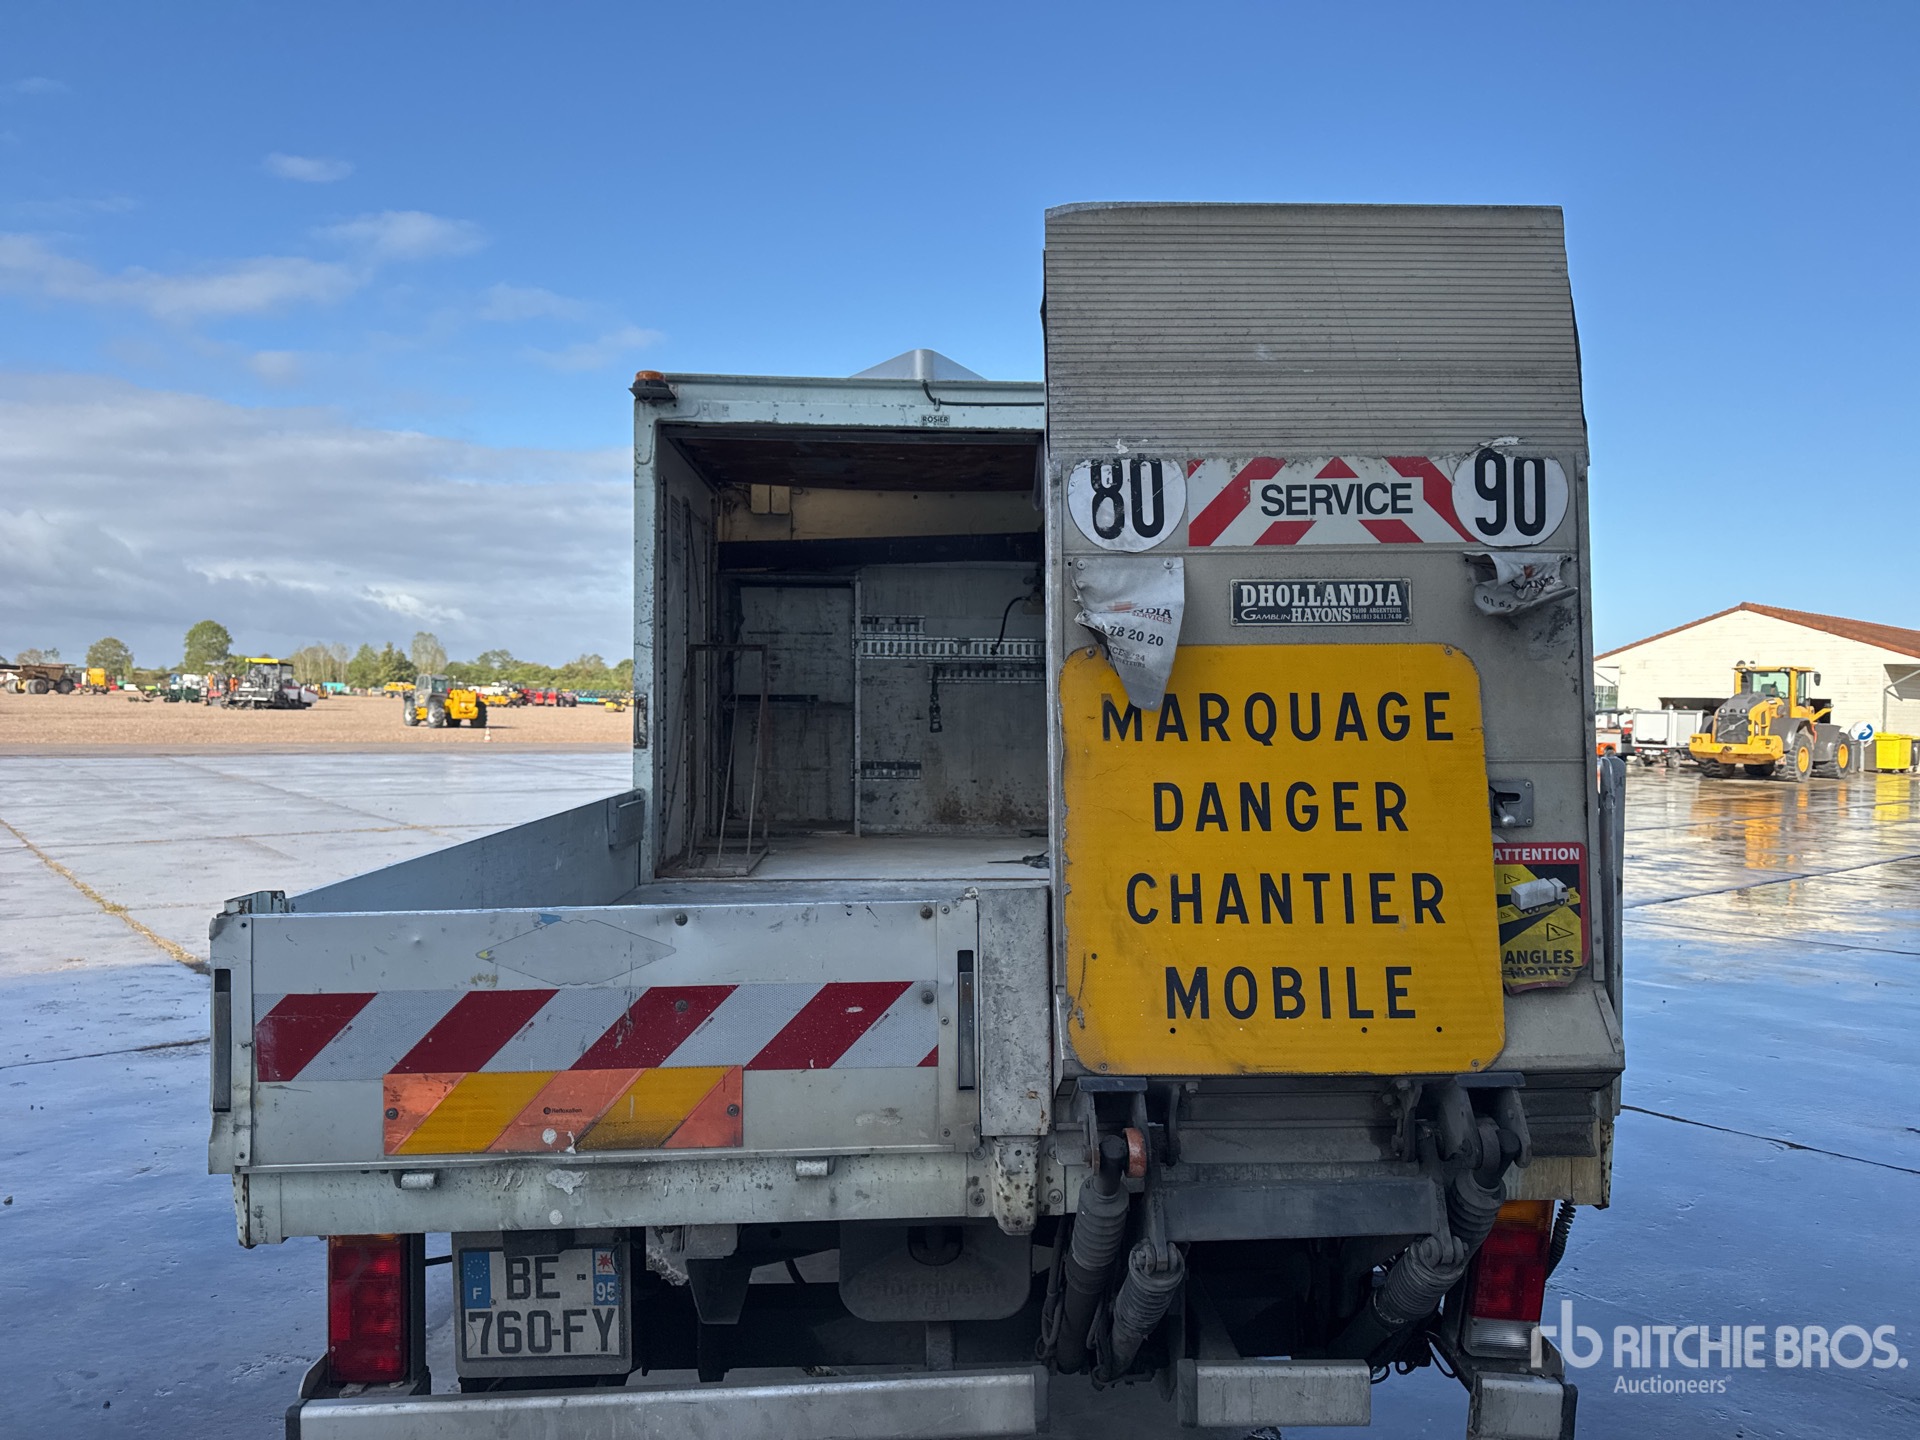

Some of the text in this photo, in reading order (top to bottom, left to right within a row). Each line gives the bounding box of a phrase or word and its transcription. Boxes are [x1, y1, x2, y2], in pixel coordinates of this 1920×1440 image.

[1090, 458, 1165, 540] 80
[1260, 482, 1414, 517] SERVICE
[1475, 449, 1547, 537] 90
[1240, 584, 1402, 607] DHOLLANDIA
[1241, 607, 1351, 622] GAMBLIN HAYONS
[1109, 625, 1125, 637] 78
[1128, 628, 1145, 642] 20
[1147, 633, 1164, 647] 20
[1101, 690, 1455, 747] MARQUAGE
[1153, 781, 1409, 832] DANGER
[1494, 847, 1580, 861] ATTENTION
[1126, 872, 1445, 925] CHANTIER
[1504, 949, 1575, 965] ANGLES
[1508, 966, 1572, 979] MORTS
[1165, 966, 1417, 1020] MOBILE
[472, 1287, 483, 1300] F
[505, 1256, 561, 1300] BE
[596, 1282, 617, 1302] 95
[468, 1308, 616, 1355] 760-FY
